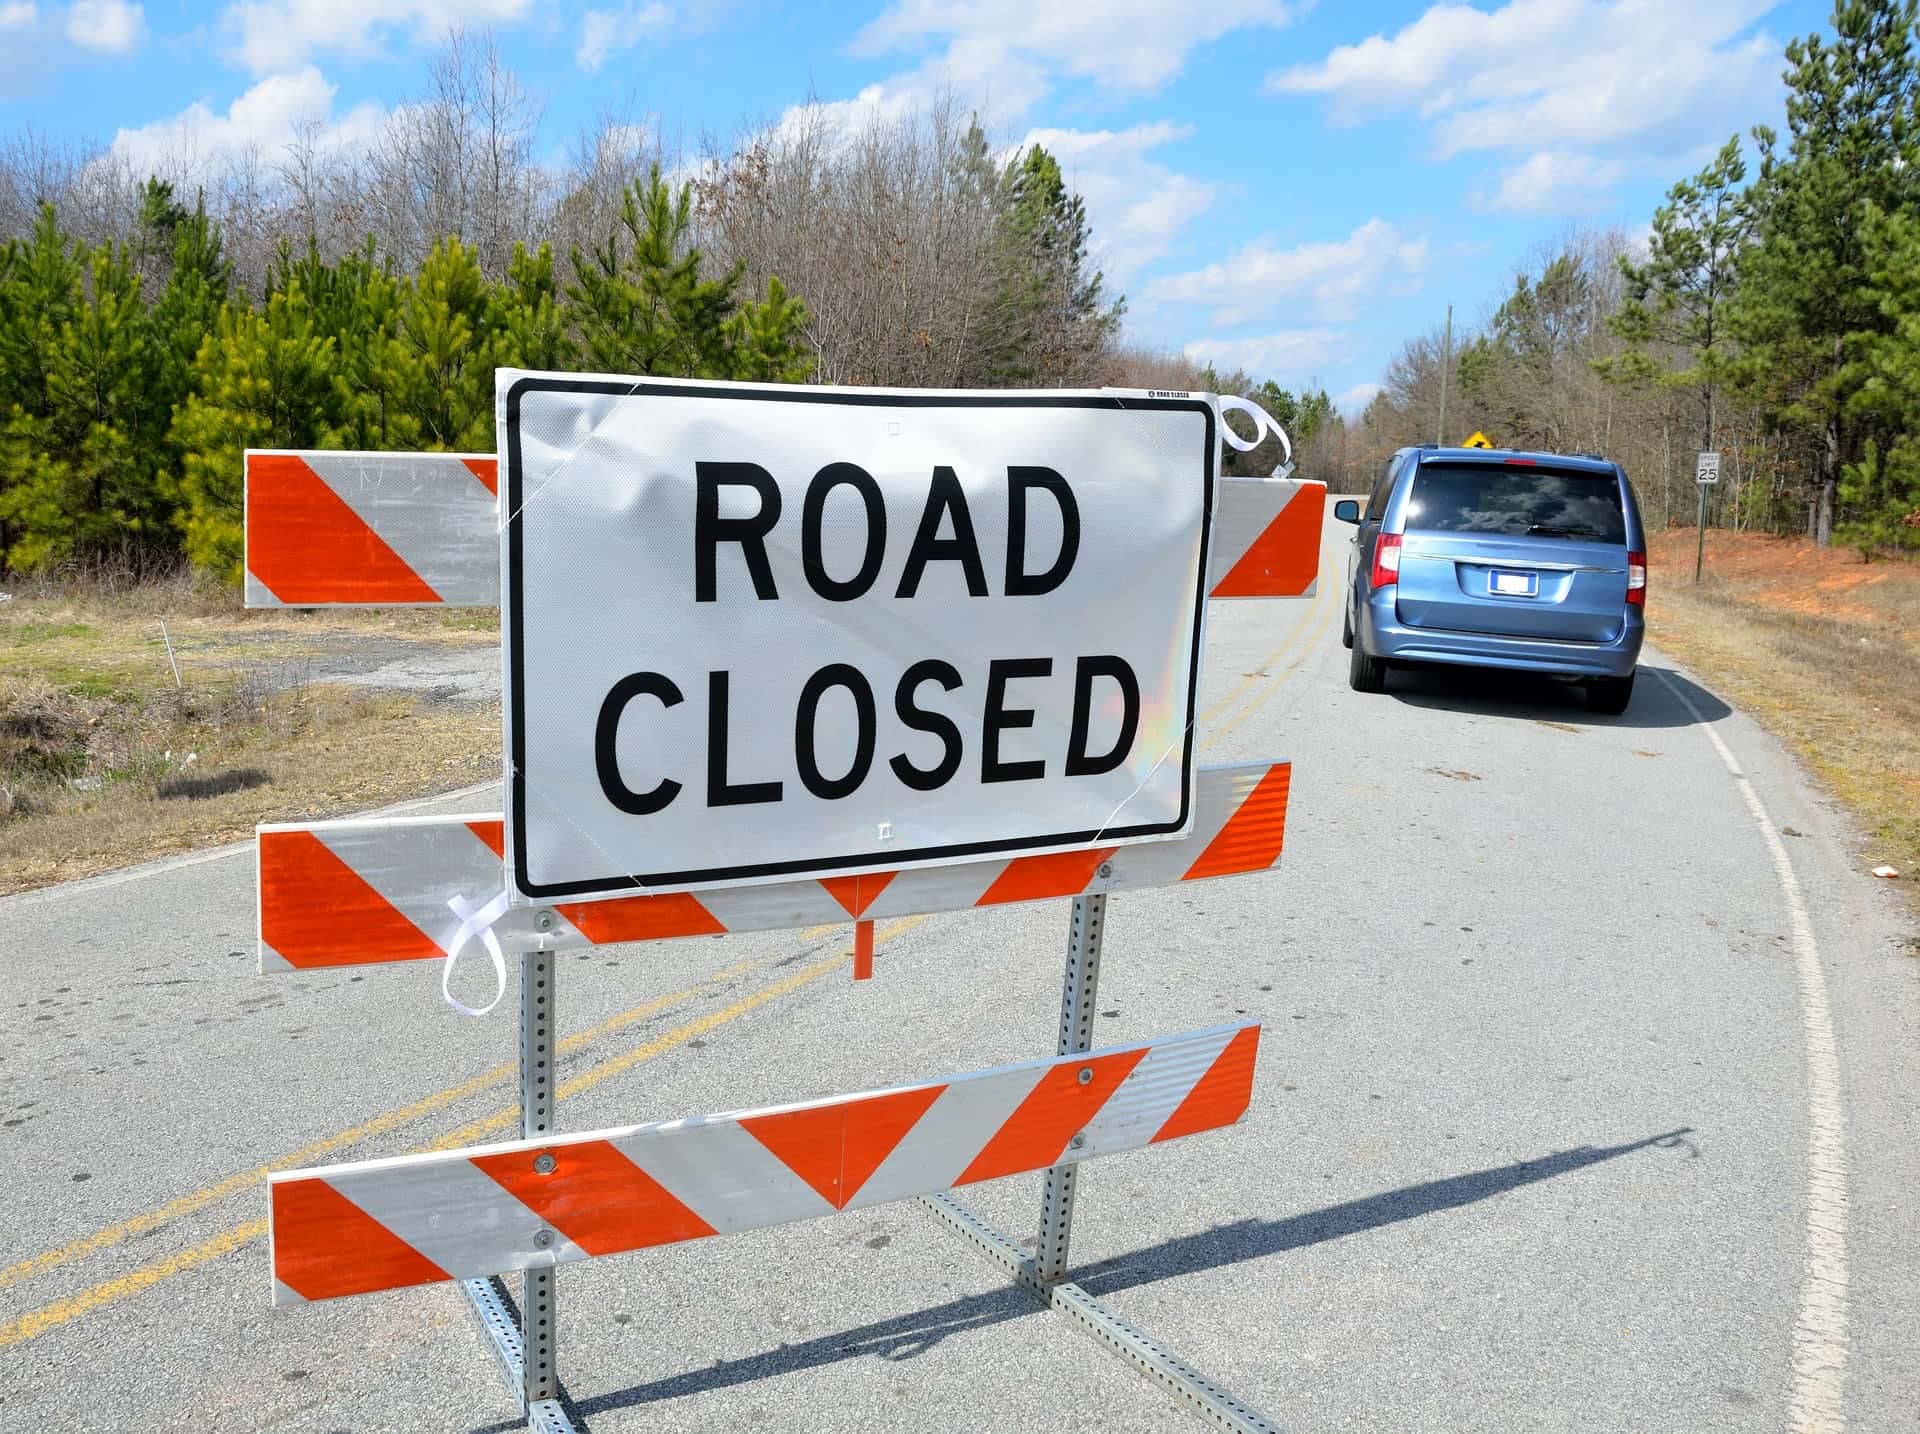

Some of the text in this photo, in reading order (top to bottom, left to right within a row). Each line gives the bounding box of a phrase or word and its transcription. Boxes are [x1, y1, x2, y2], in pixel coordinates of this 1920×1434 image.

[694, 461, 1082, 603] ROAD
[1698, 468, 1717, 480] 25
[595, 655, 1140, 816] CLOSED
